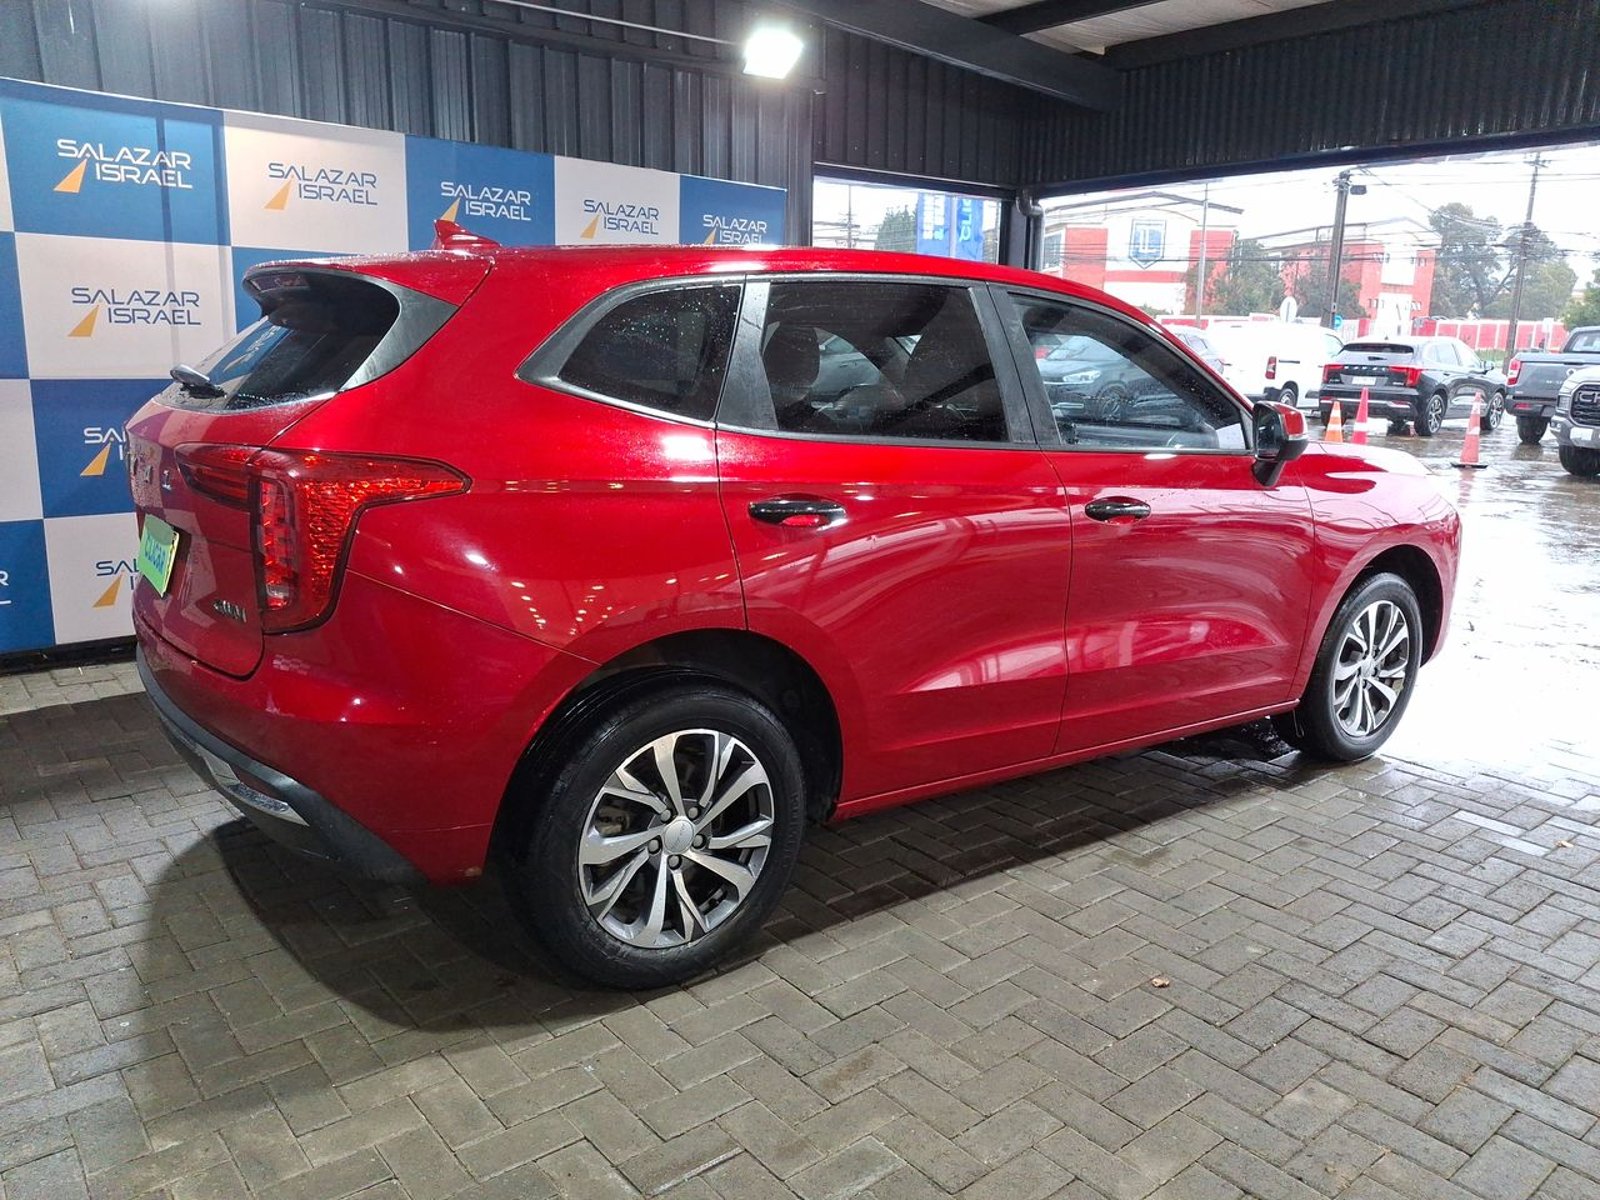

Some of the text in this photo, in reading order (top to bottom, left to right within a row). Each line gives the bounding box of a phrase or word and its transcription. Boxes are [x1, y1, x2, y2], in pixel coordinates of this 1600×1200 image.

[57, 138, 191, 170] SALAZAR
[95, 162, 193, 189] ISRAEL
[268, 162, 377, 188] SALAZAR
[299, 183, 378, 205] ISRAEL
[440, 181, 531, 206] SALAZAR
[465, 200, 532, 221] ISRAEL
[583, 199, 660, 220] SALAZAR
[603, 216, 659, 235] ISRAEL
[702, 214, 767, 234] SALAZAR
[71, 287, 200, 307] SALAZAR
[108, 307, 202, 325] ISRAEL
